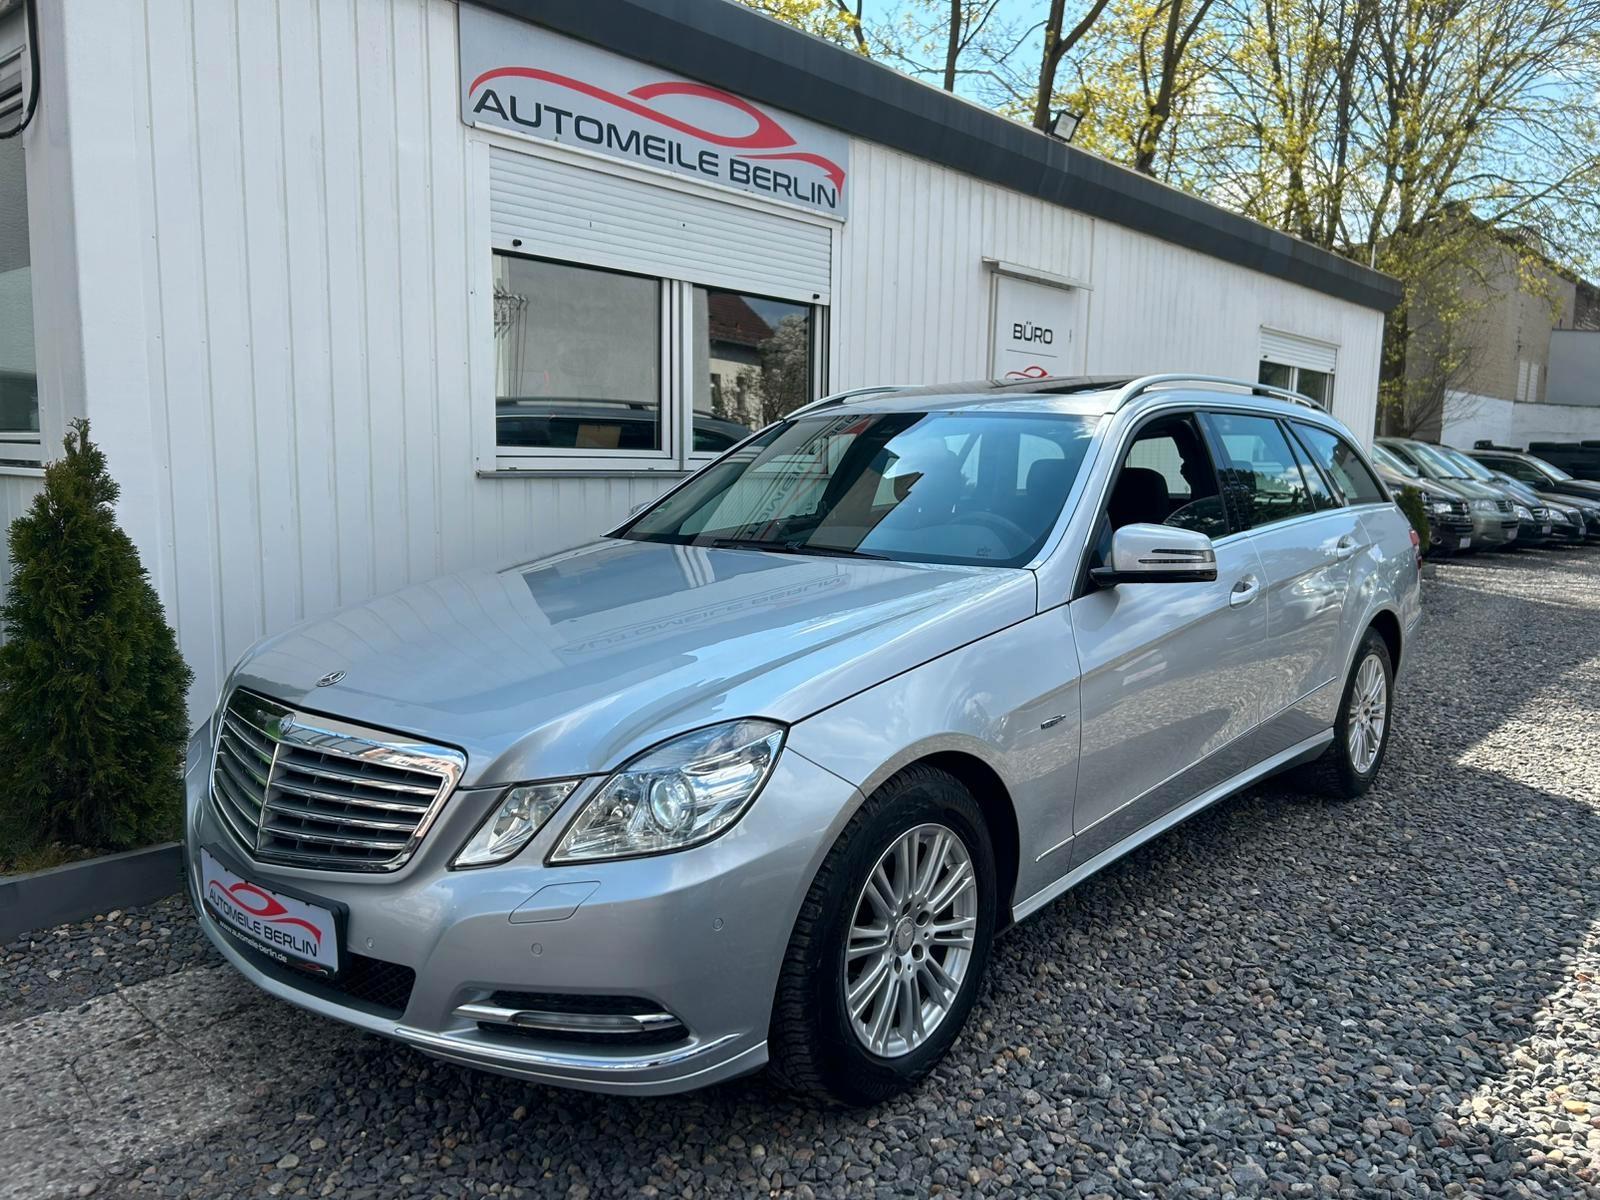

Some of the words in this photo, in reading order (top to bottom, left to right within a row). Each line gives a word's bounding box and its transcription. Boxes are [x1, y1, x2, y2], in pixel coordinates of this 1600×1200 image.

[473, 88, 719, 178] AUTOMEILE
[729, 158, 836, 209] BERLIN
[1012, 321, 1053, 344] BÜRO
[209, 888, 262, 935] AUTOMEILE
[263, 925, 317, 957] BERLIN
